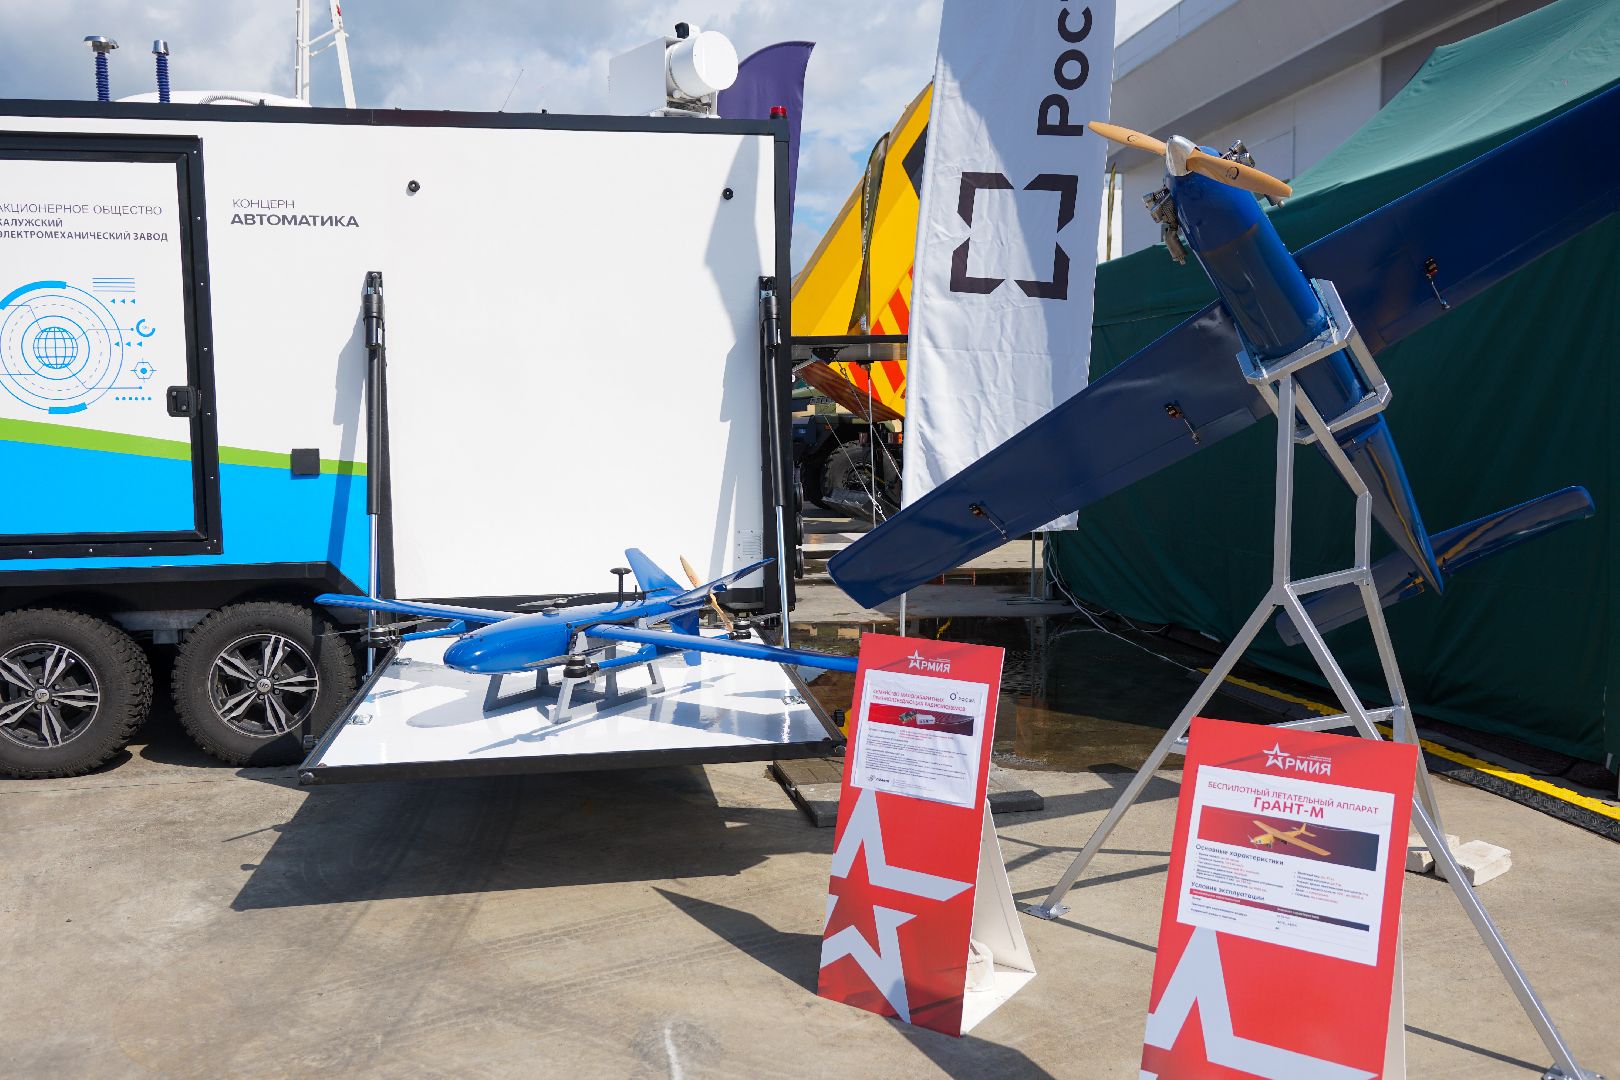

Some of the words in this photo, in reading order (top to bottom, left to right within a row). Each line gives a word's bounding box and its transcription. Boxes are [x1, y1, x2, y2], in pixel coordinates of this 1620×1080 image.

[1037, 0, 1092, 136] Рос
[93, 204, 162, 216] ОБЩЕСТВО
[232, 198, 295, 210] КОНЦЕРН
[231, 213, 360, 228] АВТОМАТИКА
[133, 232, 168, 242] ЗАВОД
[907, 649, 951, 674] АРМИЯ
[1263, 742, 1332, 777] АРМИЯ
[1208, 781, 1270, 797] БЕСПИЛОТНЫЙ
[1271, 791, 1334, 808] ЛЕТАТЕЛЬНЫЙ
[1336, 800, 1379, 814] АППАРАТ
[1253, 797, 1324, 819] ГрАНТ-М
[1195, 844, 1228, 855] Основные
[1229, 851, 1284, 866] характеристики
[1191, 882, 1216, 891] Условия
[1218, 888, 1265, 901] эксплуатации
